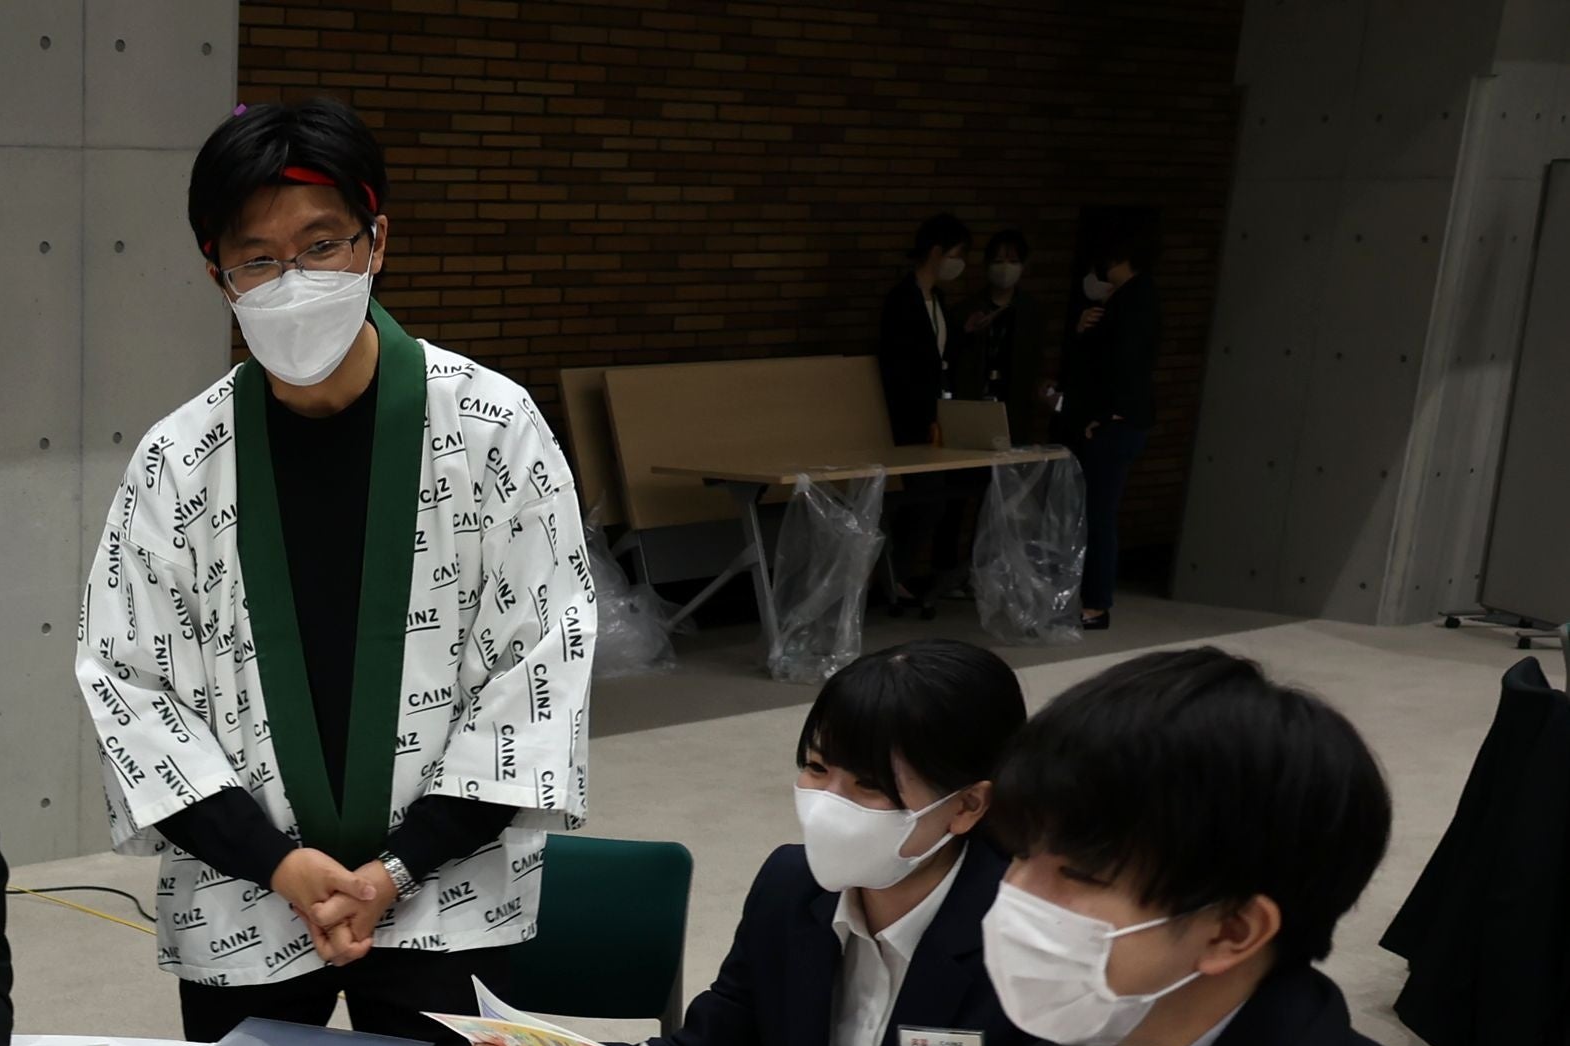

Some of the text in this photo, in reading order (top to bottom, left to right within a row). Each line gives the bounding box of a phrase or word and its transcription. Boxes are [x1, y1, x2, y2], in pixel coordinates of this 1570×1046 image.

[426, 363, 476, 374] AINZ
[207, 377, 234, 405] CAI
[459, 397, 514, 422] CAINZ
[183, 422, 229, 467] CAINZ
[432, 431, 464, 451] CAI
[212, 505, 236, 529] CAI
[453, 512, 479, 528] CAI
[108, 531, 121, 588] CAINZ
[433, 563, 459, 583] CAI
[568, 549, 597, 604] CAINZ
[201, 610, 220, 638] INZ
[408, 608, 439, 627] INZ
[480, 628, 500, 665] CAIN
[565, 606, 584, 660] CAINZ
[91, 678, 131, 726] CAINZ
[408, 686, 453, 707] CAIN
[533, 663, 551, 722] CAINZ
[152, 696, 190, 744] CAINZ
[105, 736, 146, 785] CAINZ
[501, 725, 516, 780] CAINZ
[155, 760, 196, 806] CAINZ
[541, 771, 556, 809] CAIN
[512, 850, 543, 873] CAINZ
[439, 881, 474, 905] INZ
[484, 896, 522, 924] CAINZ
[209, 926, 261, 954] CAINZ
[265, 933, 314, 968] CAINZ
[398, 934, 443, 949] CAIN
